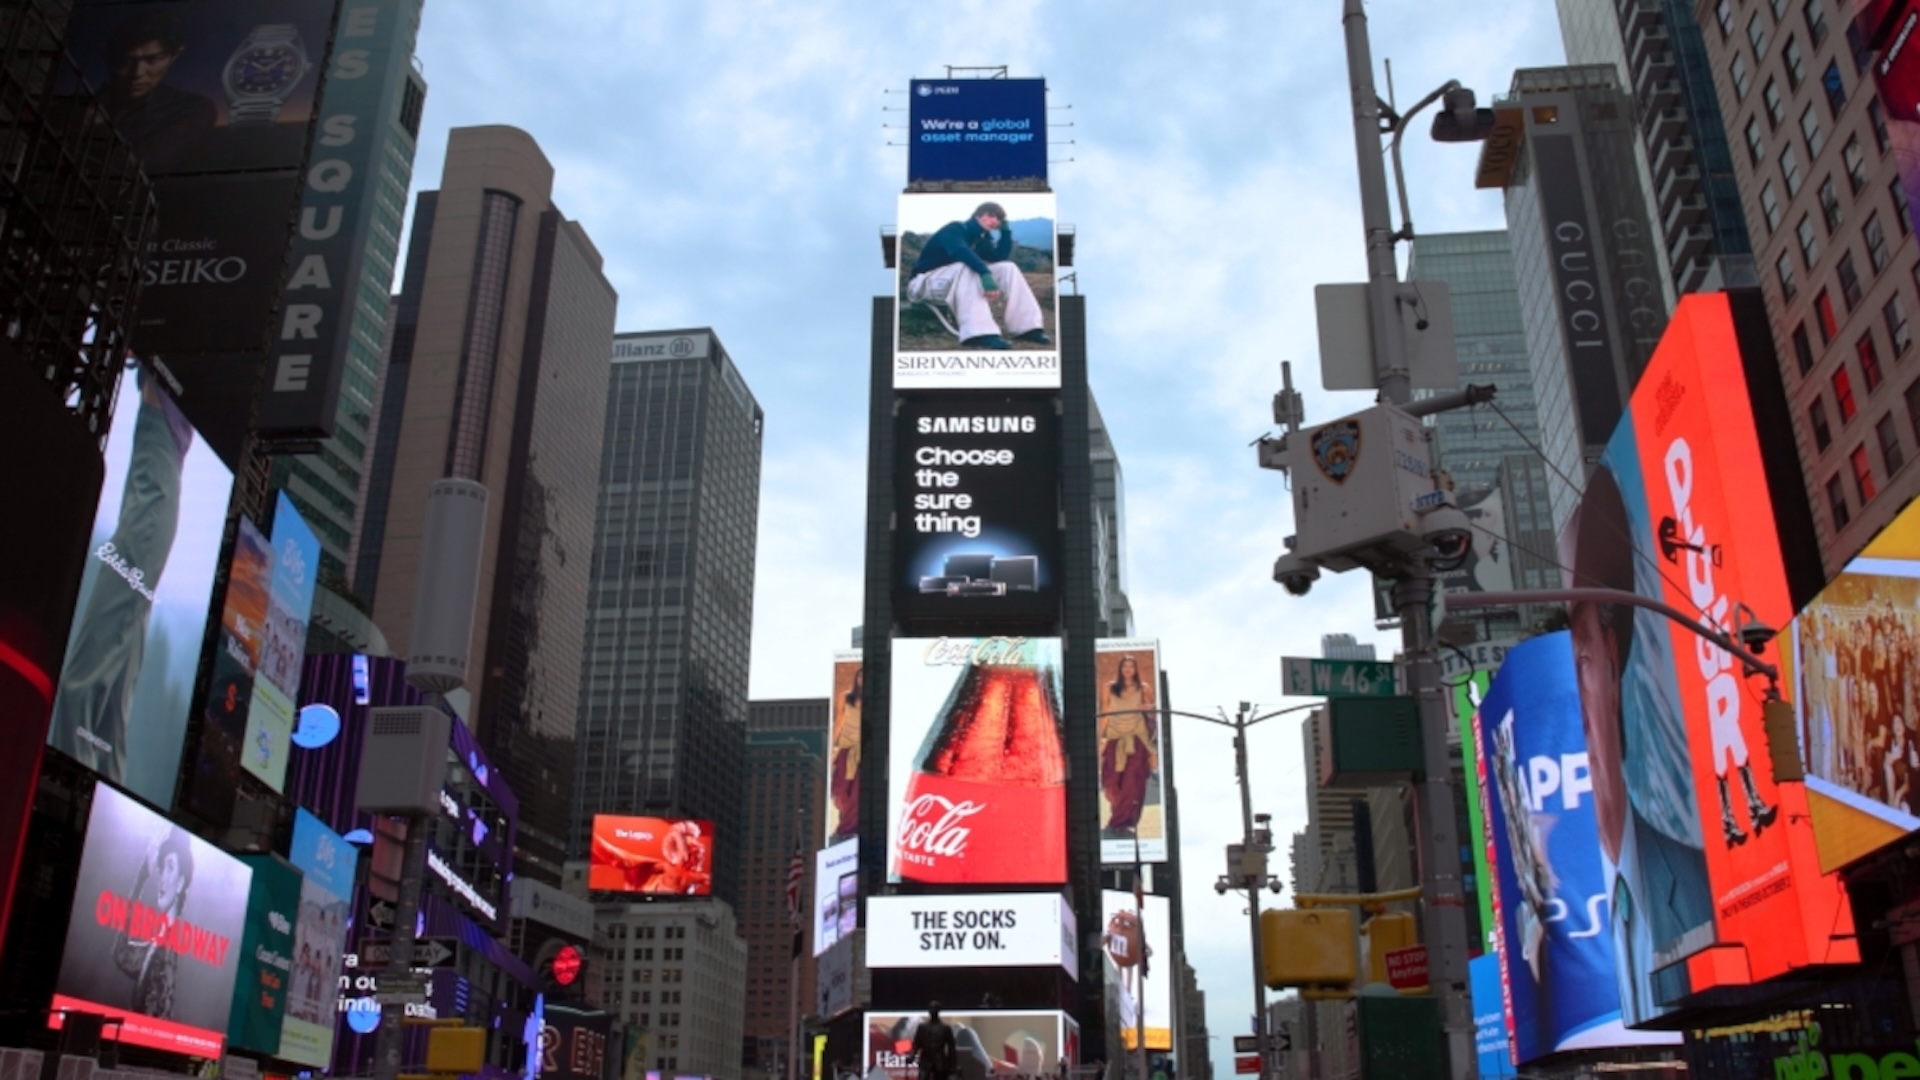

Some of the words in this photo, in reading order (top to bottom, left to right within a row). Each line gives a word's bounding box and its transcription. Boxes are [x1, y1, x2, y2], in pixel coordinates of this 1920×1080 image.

[921, 119, 965, 130] We're
[967, 121, 979, 130] a
[981, 118, 1030, 132] global
[920, 133, 961, 143] asset
[965, 134, 1034, 145] manager
[161, 237, 217, 253] Classic
[273, 114, 356, 392] SQUARE
[142, 256, 247, 287] SEIKO
[1555, 221, 1604, 348] GUCCI
[614, 344, 666, 357] llianz
[897, 356, 1057, 370] SIRIVANNAVARI
[917, 416, 1036, 433] SAMSUNG
[915, 446, 1014, 465] Choose
[915, 469, 959, 487] the
[915, 493, 972, 510] sure
[915, 512, 981, 538] thing
[1314, 663, 1332, 692] W
[1341, 664, 1369, 694] 46
[95, 890, 128, 934] ON
[128, 901, 230, 968] BROADWAY
[911, 909, 947, 930] THE
[953, 909, 1017, 929] SOCKS
[920, 931, 965, 951] STAY
[973, 930, 1006, 950] ON.
